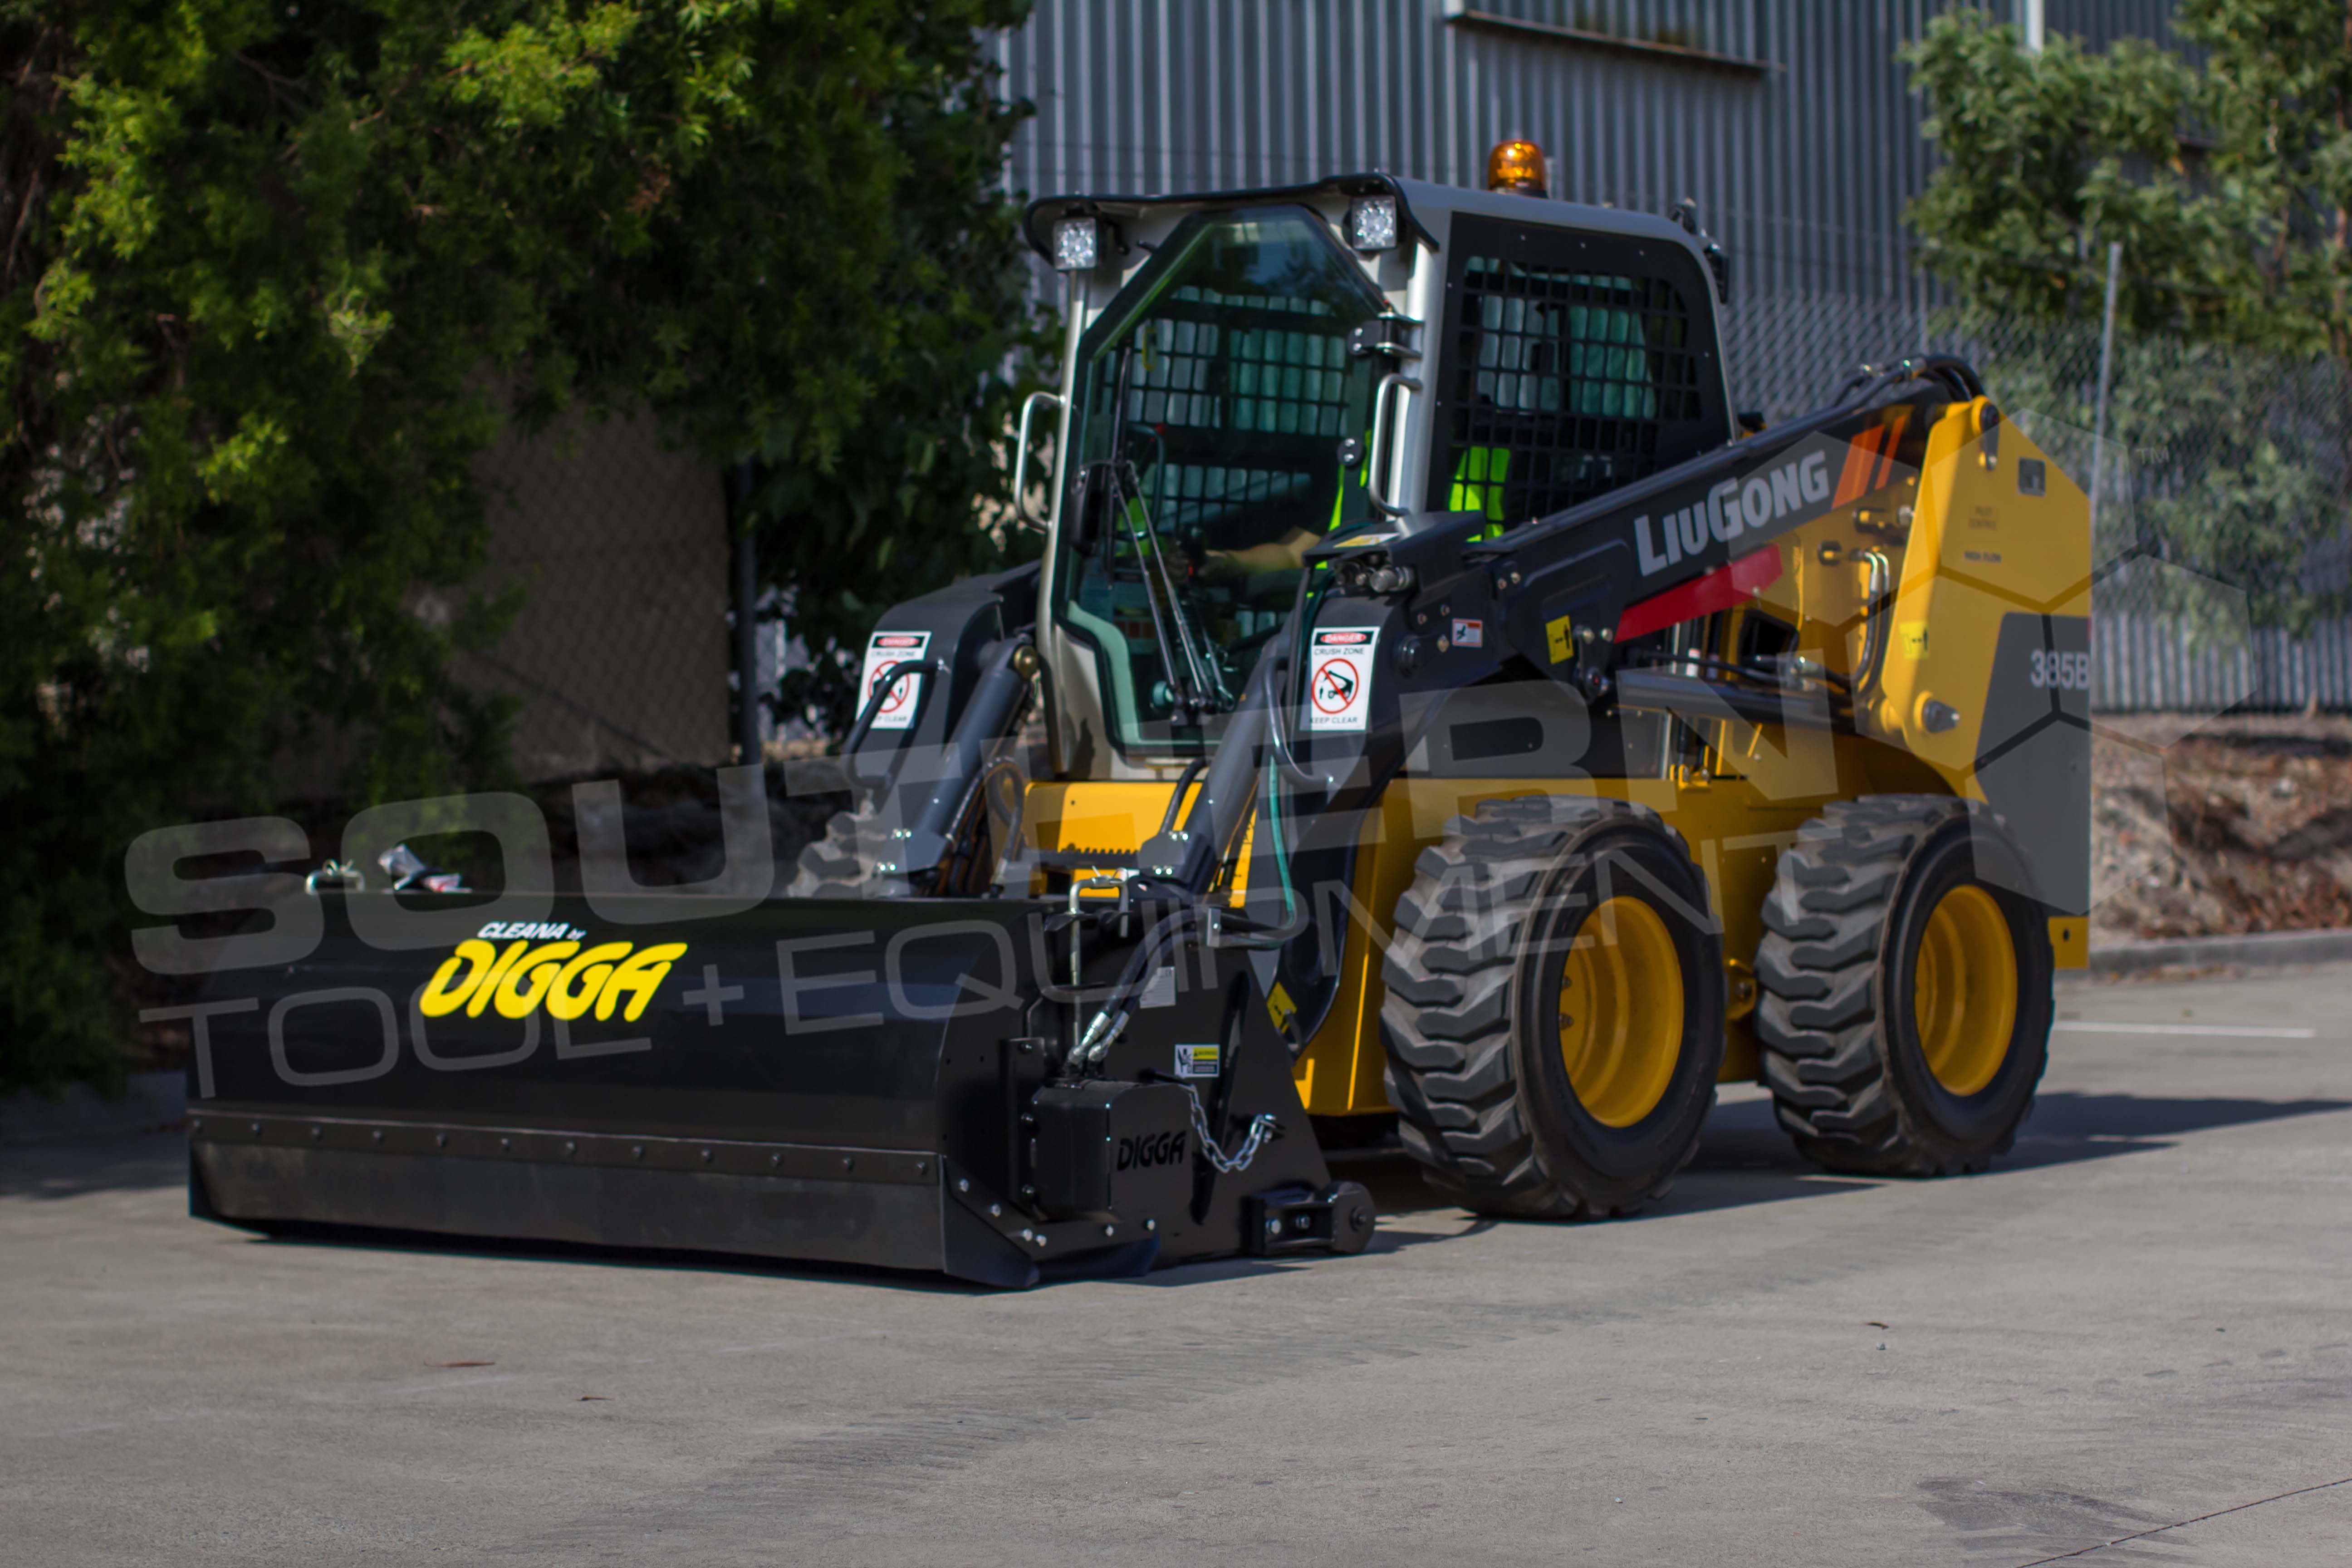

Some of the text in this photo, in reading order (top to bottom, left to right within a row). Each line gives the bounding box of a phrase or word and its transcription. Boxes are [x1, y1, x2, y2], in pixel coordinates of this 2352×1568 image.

[1323, 634, 1362, 643] DANGER
[2030, 648, 2090, 690] 385B
[1332, 715, 1358, 724] CLEAR
[477, 921, 570, 940] CLEANA
[419, 938, 688, 1022] DIGGA
[1117, 1131, 1187, 1171] DIGGA
